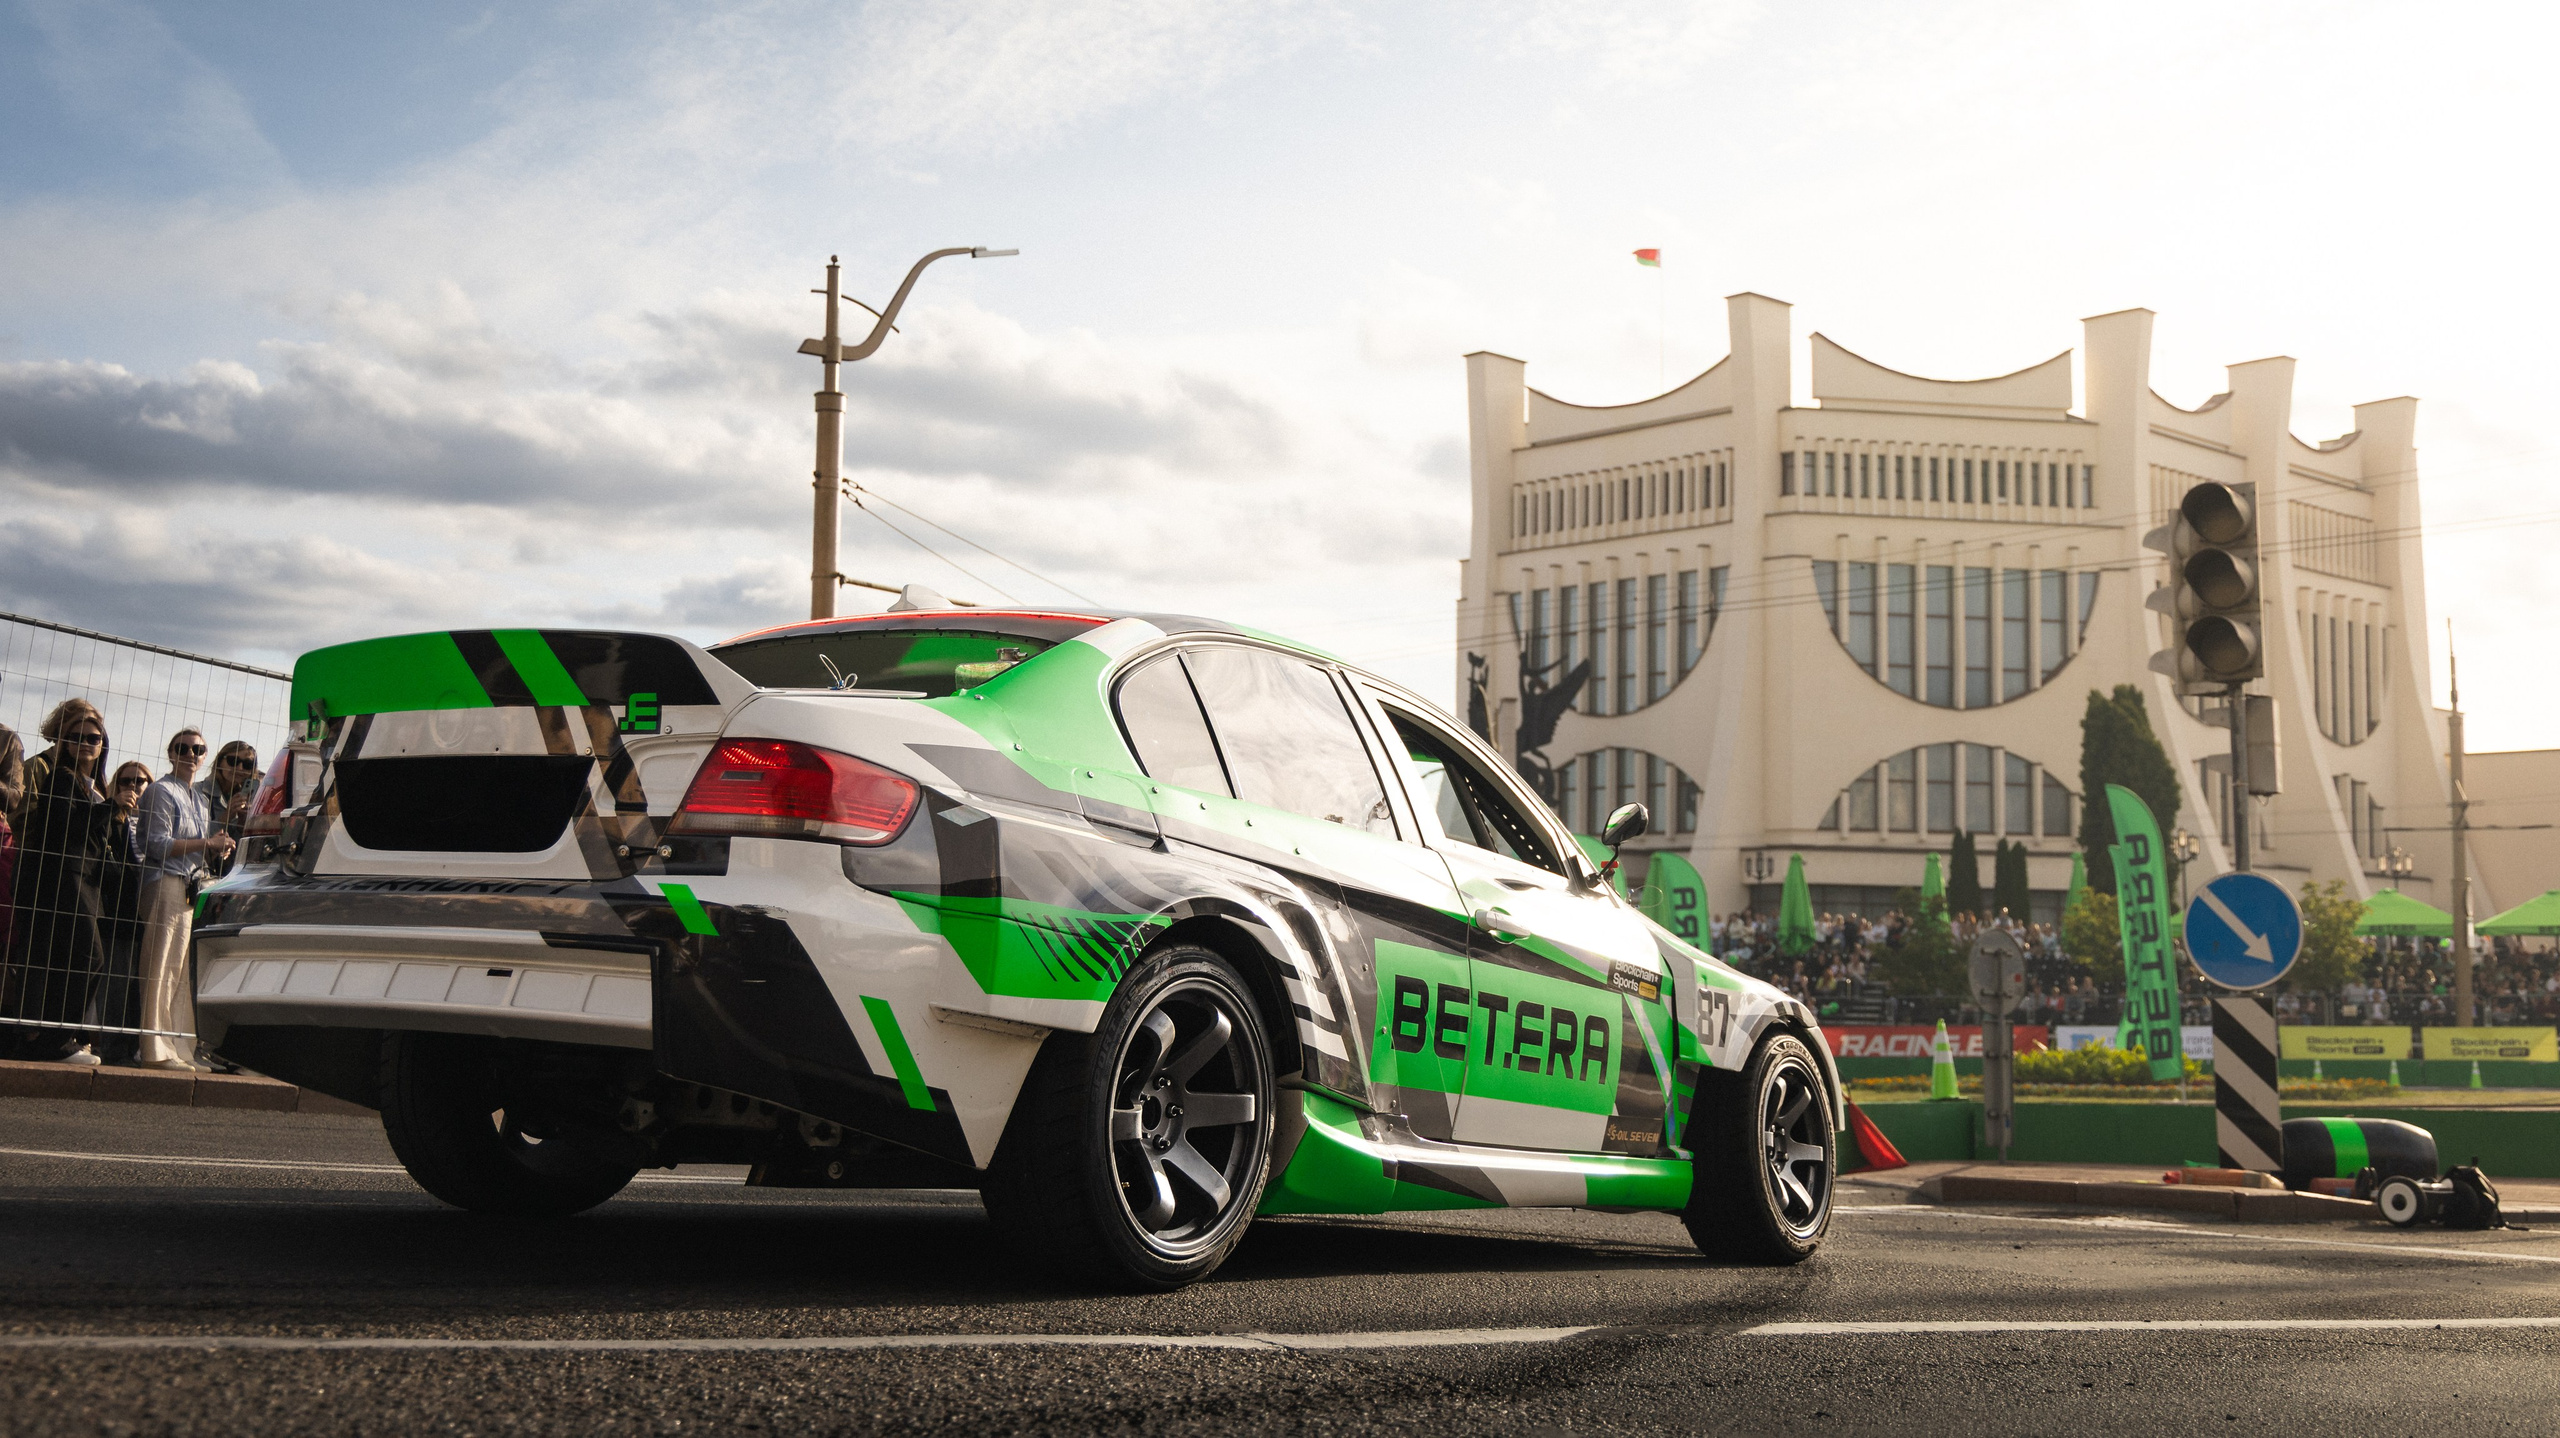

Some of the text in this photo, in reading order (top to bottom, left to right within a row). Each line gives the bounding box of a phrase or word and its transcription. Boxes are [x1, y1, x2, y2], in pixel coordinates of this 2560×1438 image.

[1612, 973, 1639, 992] Sports
[1697, 988, 1729, 1048] 87
[1629, 1131, 1660, 1143] SEVEN
